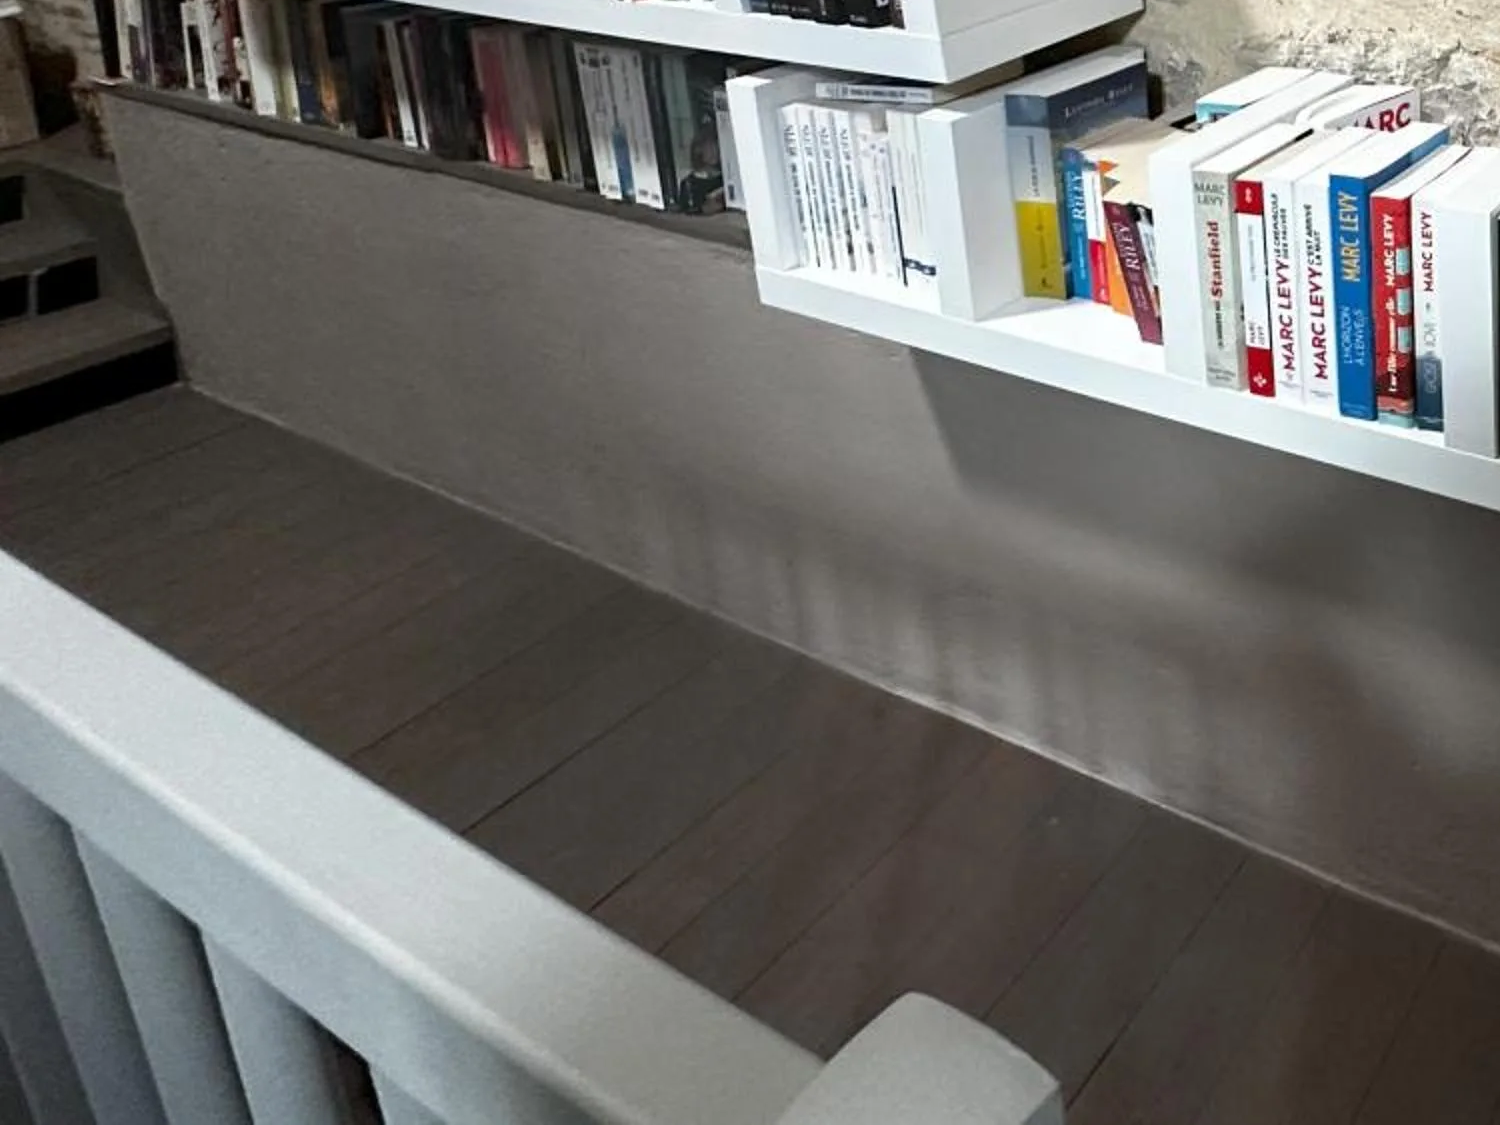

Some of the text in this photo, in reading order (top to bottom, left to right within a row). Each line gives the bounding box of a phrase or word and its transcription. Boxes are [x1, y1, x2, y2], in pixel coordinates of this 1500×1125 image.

[1193, 182, 1226, 197] MARC
[1123, 225, 1142, 271] RILEY
[1207, 220, 1224, 299] Stanfield
[1339, 190, 1361, 283] MARC LEVY
[1383, 213, 1396, 288] MARC LEVY
[1423, 211, 1436, 292] MARC LEVY
[1275, 257, 1296, 372] MARC LEVY
[1307, 266, 1329, 380] MARC LEVY
